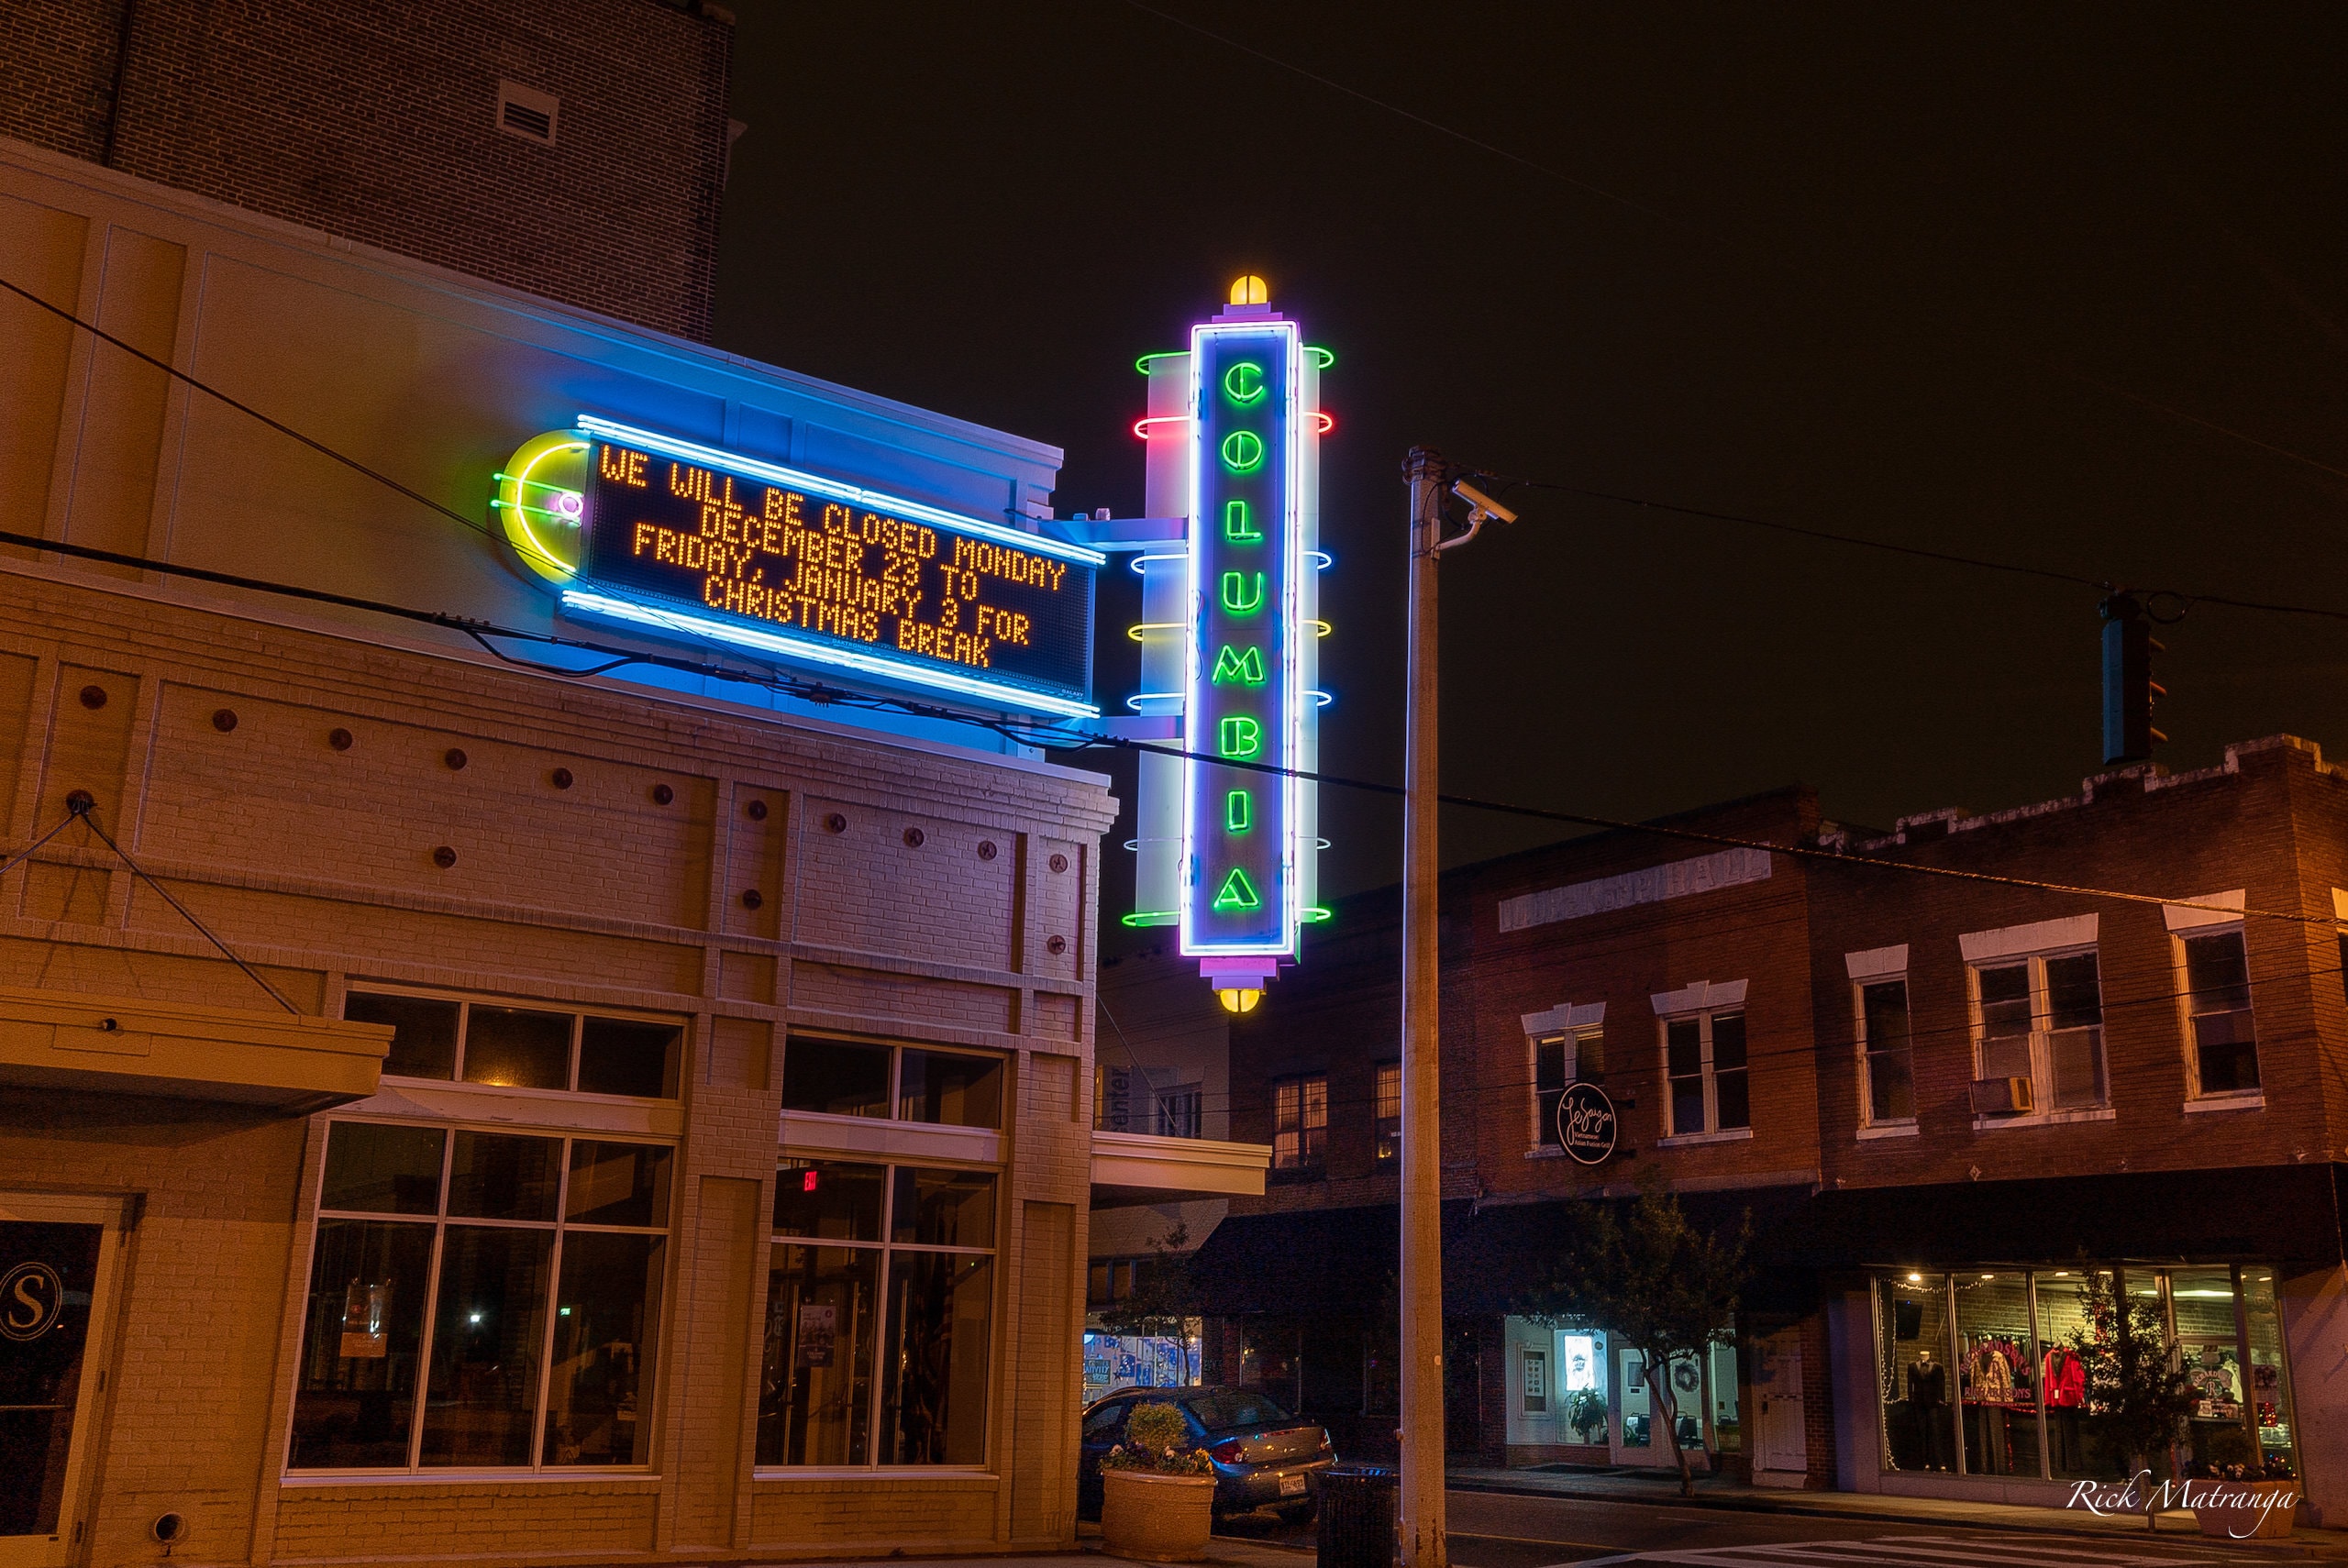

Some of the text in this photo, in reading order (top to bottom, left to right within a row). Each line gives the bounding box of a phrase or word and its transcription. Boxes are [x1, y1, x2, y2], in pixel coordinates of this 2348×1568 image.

[599, 445, 1067, 591] WE WILL BE CLOSED MONDAY
[701, 504, 978, 601] DECEMBER 23 TO
[634, 522, 1030, 646] FRIDAY, JANUARY 3 FOR
[703, 576, 991, 668] CHRISTMAS BREAK
[832, 638, 873, 652] DAKTRONICS
[1212, 361, 1265, 911] COLUMBIA
[1061, 689, 1084, 697] GALAXY
[8, 1275, 44, 1328] S
